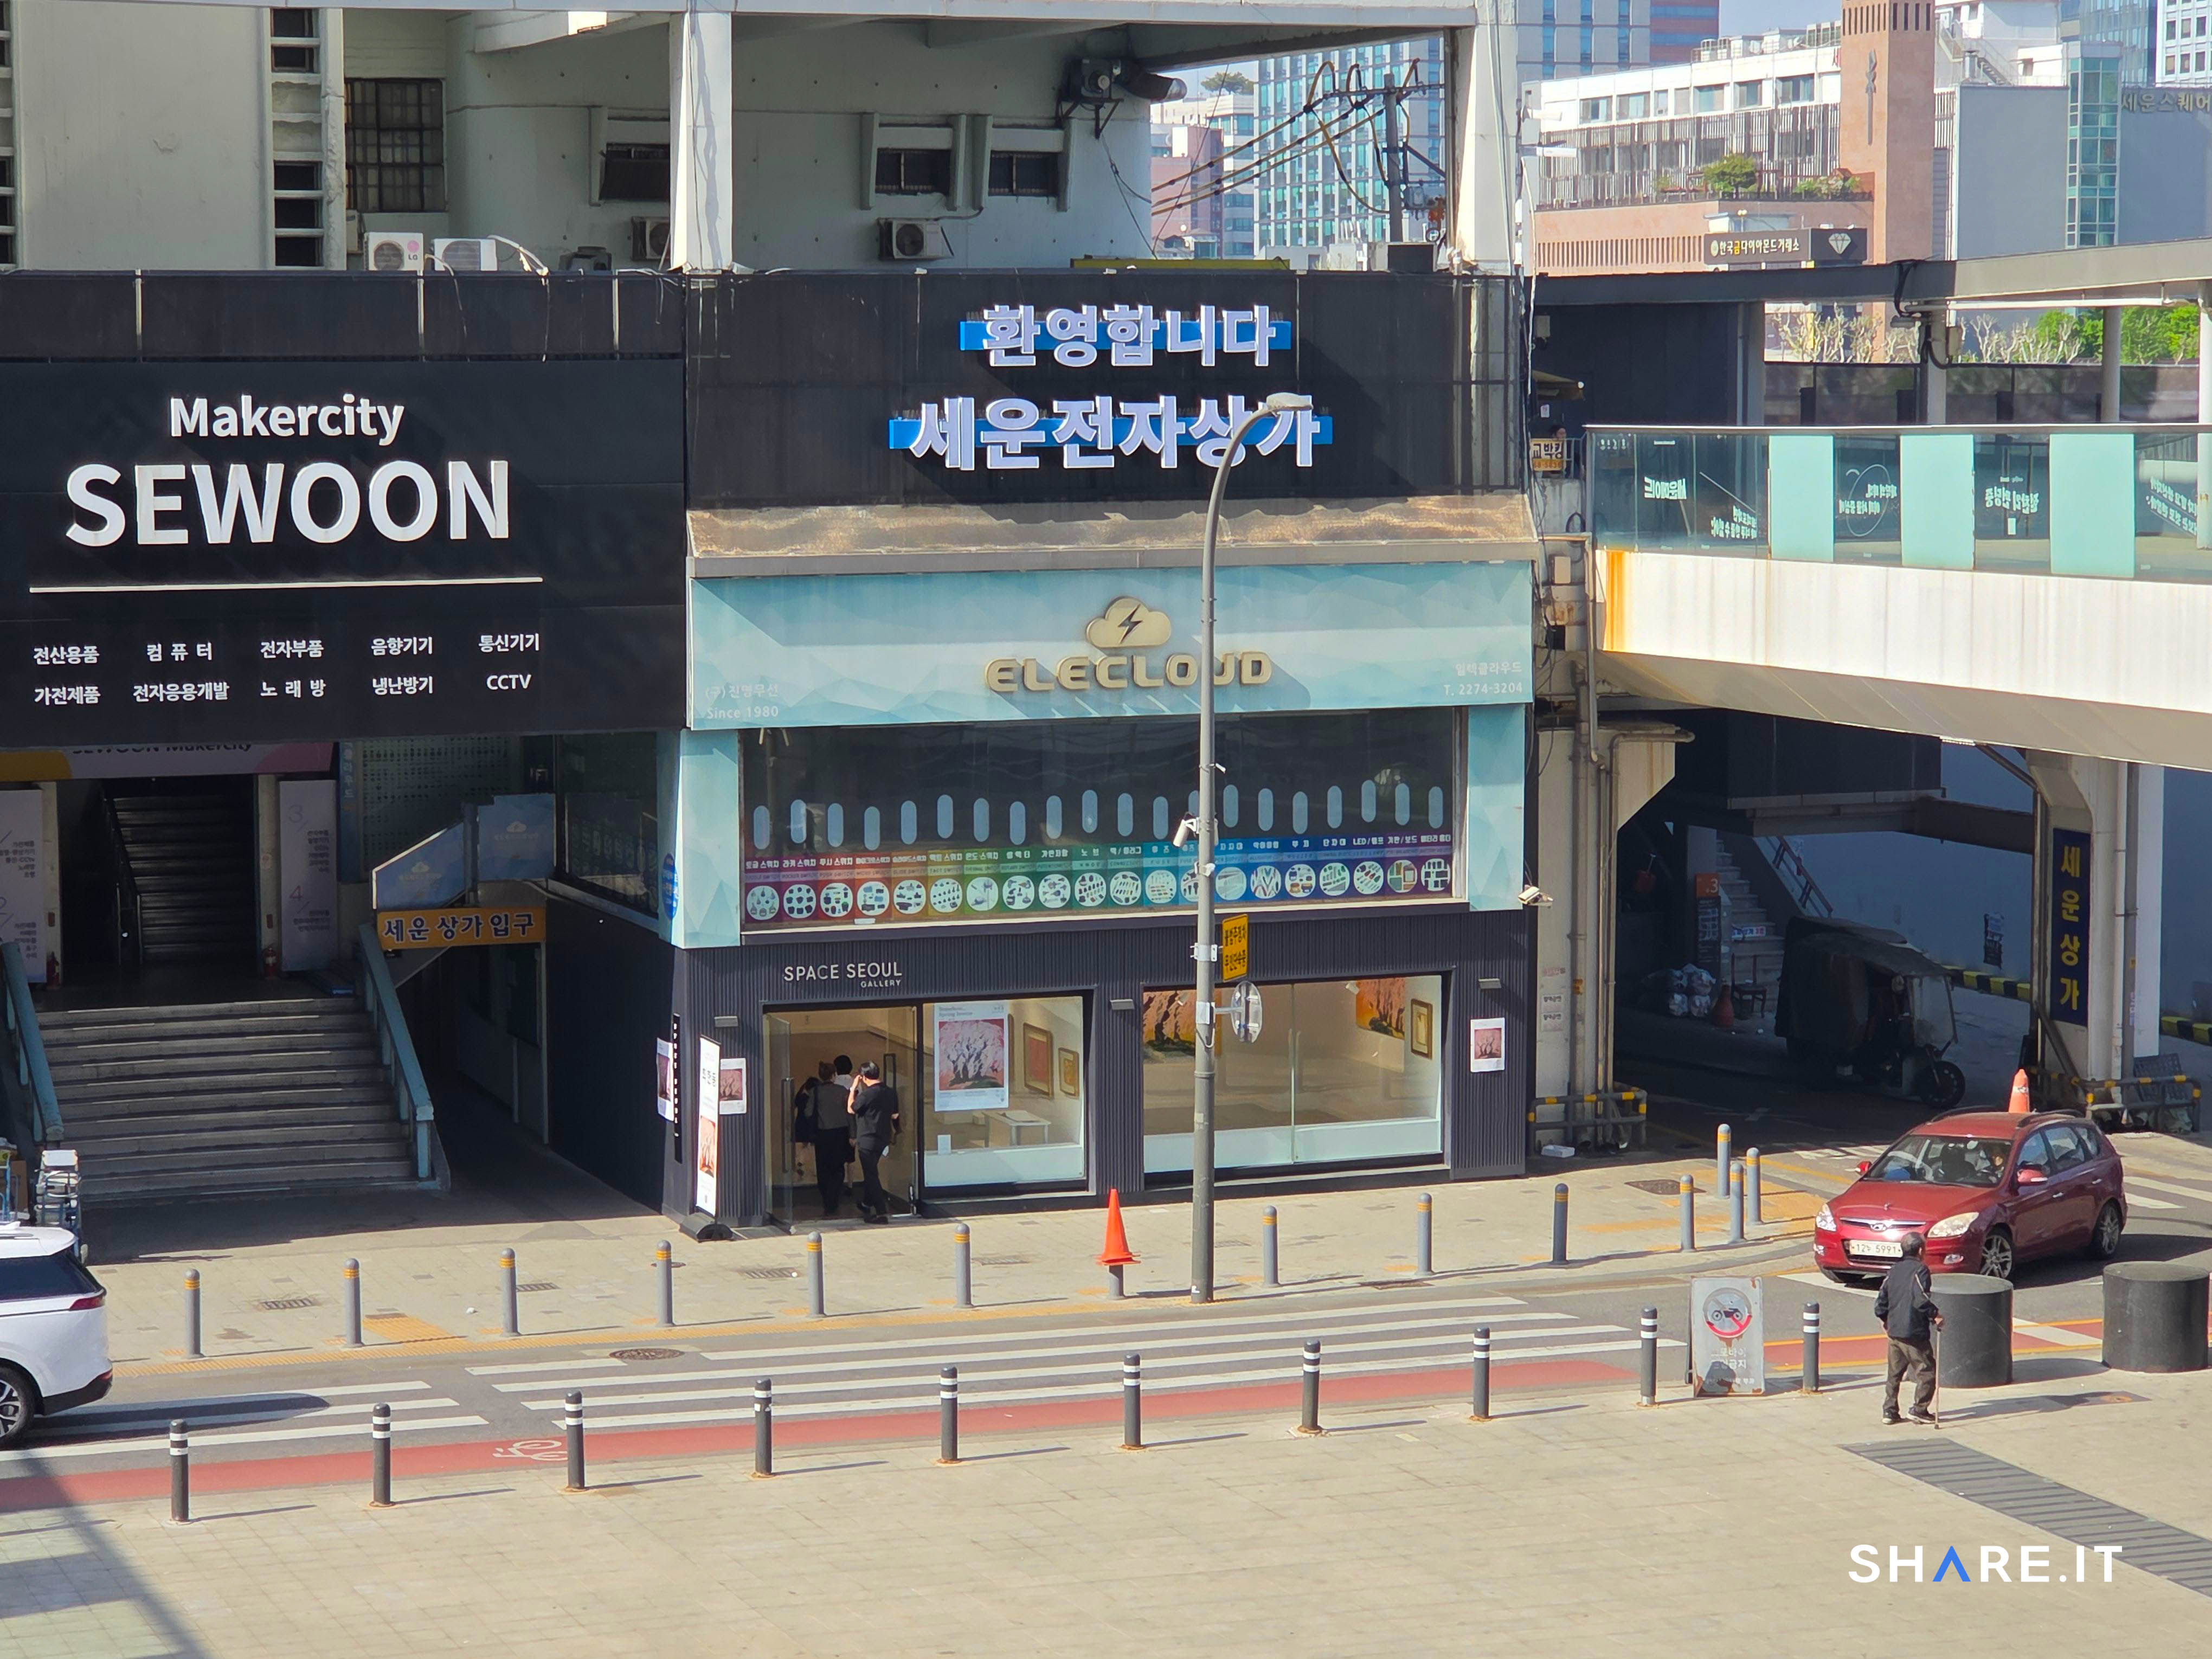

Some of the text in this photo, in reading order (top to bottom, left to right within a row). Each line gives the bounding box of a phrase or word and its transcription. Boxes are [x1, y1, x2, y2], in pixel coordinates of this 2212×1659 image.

[982, 305, 1276, 367] 환영합니다
[170, 394, 404, 446] Makercity
[910, 395, 1321, 471] 세운전자상가
[66, 460, 509, 546] SEWOON
[260, 640, 324, 659] 전자부품
[371, 636, 433, 655] 음향기기
[478, 633, 541, 652] 통신기기
[33, 646, 100, 665] 전산용품
[146, 644, 213, 662] 컴퓨터
[132, 681, 230, 702] 전자응용개발
[260, 679, 326, 698] 노래방
[372, 676, 434, 695] 냉난방기
[486, 674, 532, 691] CCTV
[1443, 682, 1522, 696] T. 2274-3204
[34, 686, 101, 705] 가전제품
[707, 705, 779, 719] Since 1980
[383, 913, 534, 942] 세운 상가 입구
[2060, 846, 2081, 1012] 세운상가
[783, 962, 902, 981] SPACE SEOUL
[860, 979, 902, 988] GALLERY
[1876, 1245, 1896, 1254] 5991
